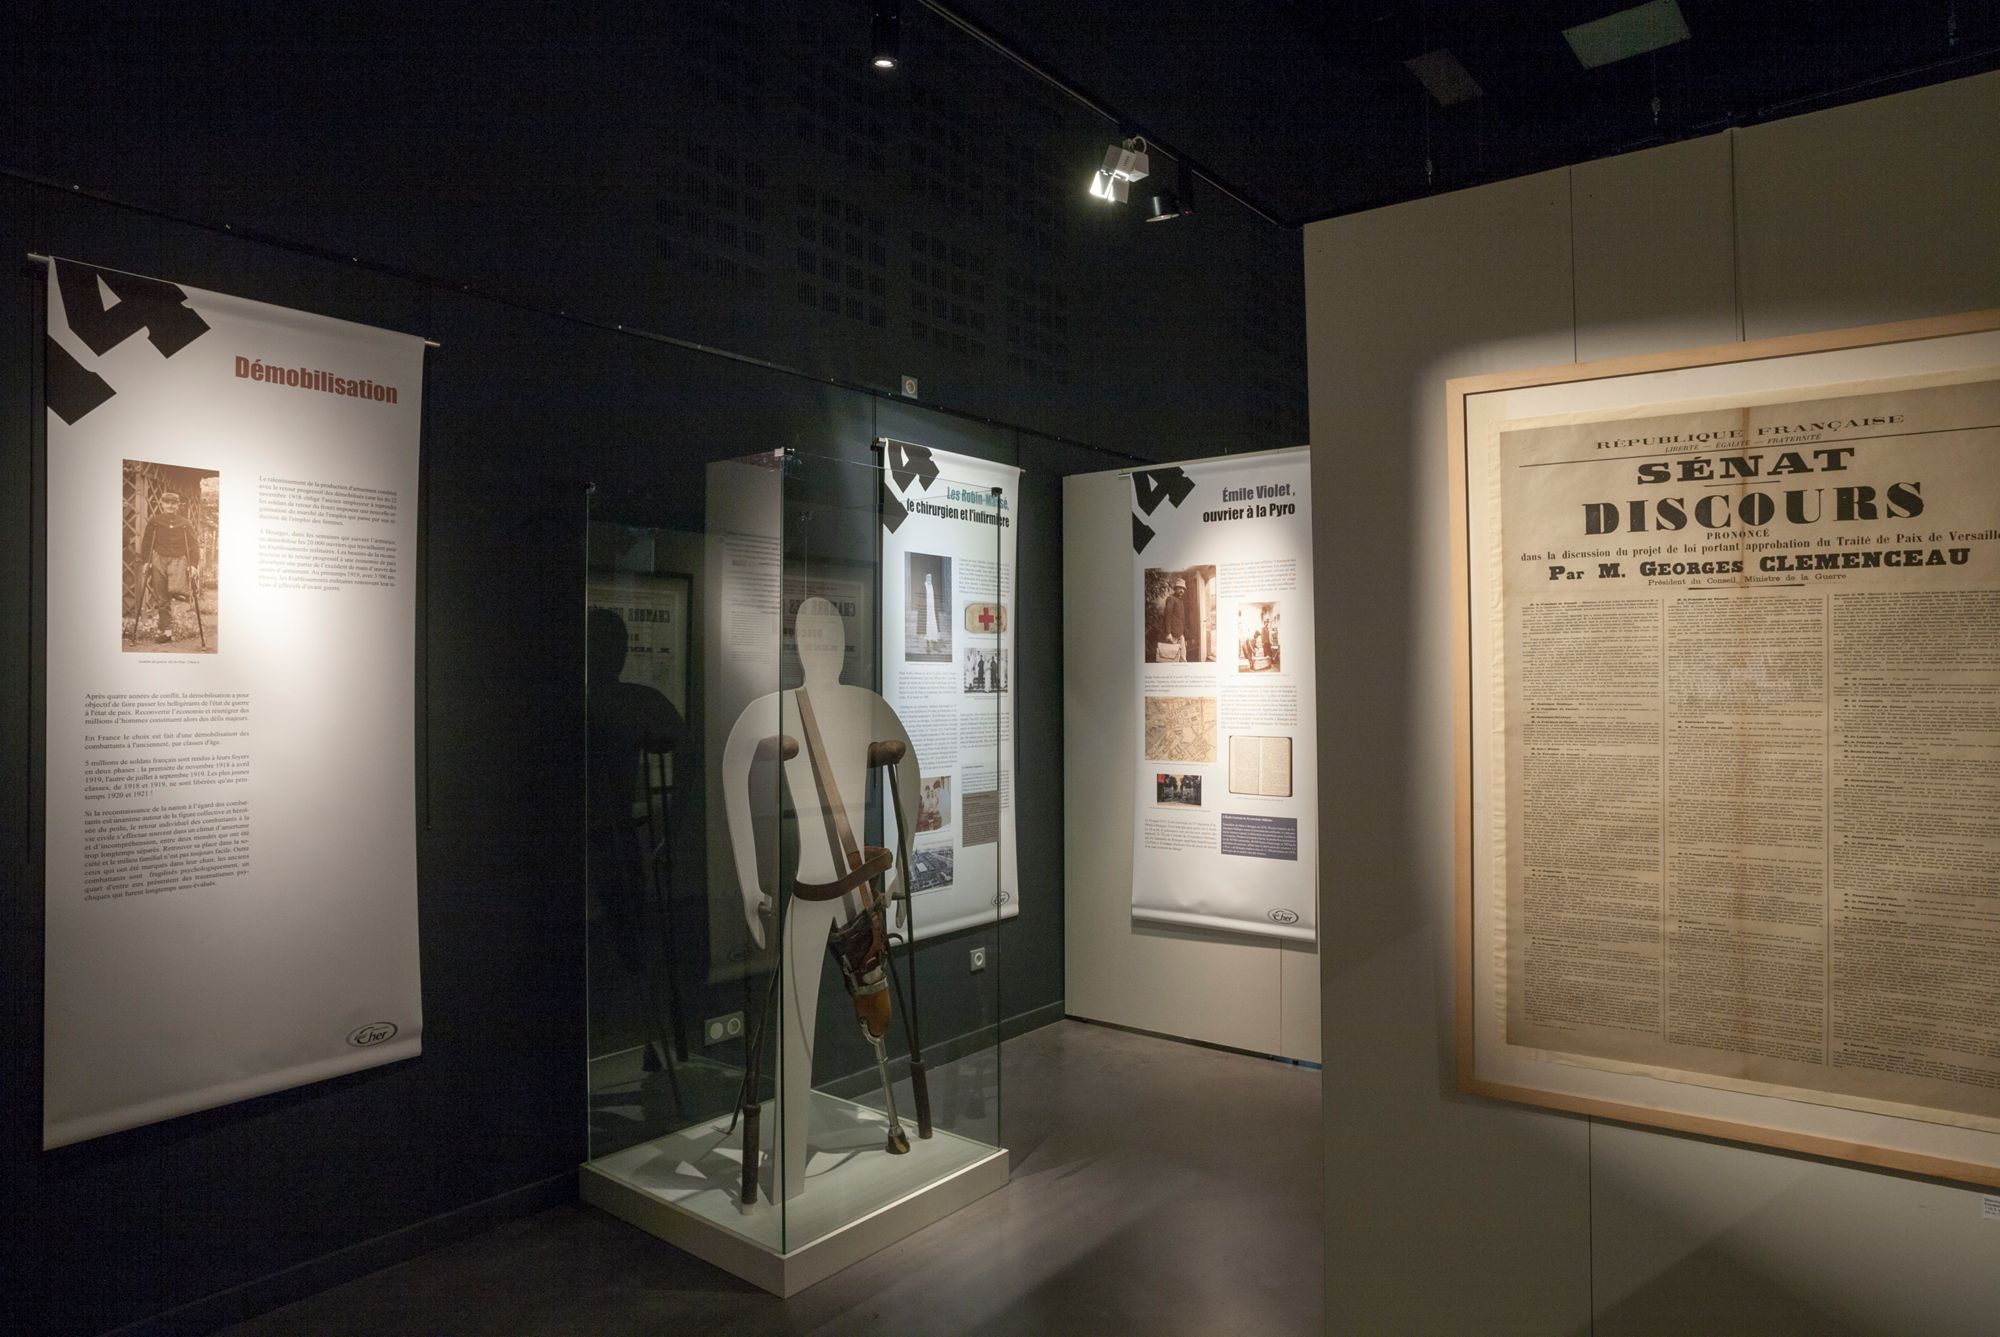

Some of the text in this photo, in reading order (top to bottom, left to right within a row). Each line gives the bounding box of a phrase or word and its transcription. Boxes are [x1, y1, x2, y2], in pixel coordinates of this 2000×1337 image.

[235, 356, 398, 404] Démobilisation
[1597, 414, 1904, 449] RÉPUBLIQUE FRANÇAISE
[1665, 444, 1700, 453] LIBERTÉ
[1767, 432, 1821, 445] FRATERNITÉ
[1637, 448, 1855, 485] SÉNAT
[947, 486, 1009, 511] Les Robin-Masé,
[1222, 487, 1254, 502] Émile
[906, 498, 915, 512] le
[916, 500, 958, 519] chirurgien
[960, 508, 968, 521] et
[1203, 503, 1295, 523] ouvrier à la Pyro
[1582, 481, 1924, 536] DISCOURS
[1521, 530, 2000, 561] dans la discussion du projet de loi portant approbation du Traité de Paix de Versaill
[1707, 528, 1770, 540] PRONONCÉ
[1549, 548, 1970, 581] Par M. GEORGES CLEMENCEAU
[1648, 573, 1847, 586] Président du Conseil Ministre de la Guerre
